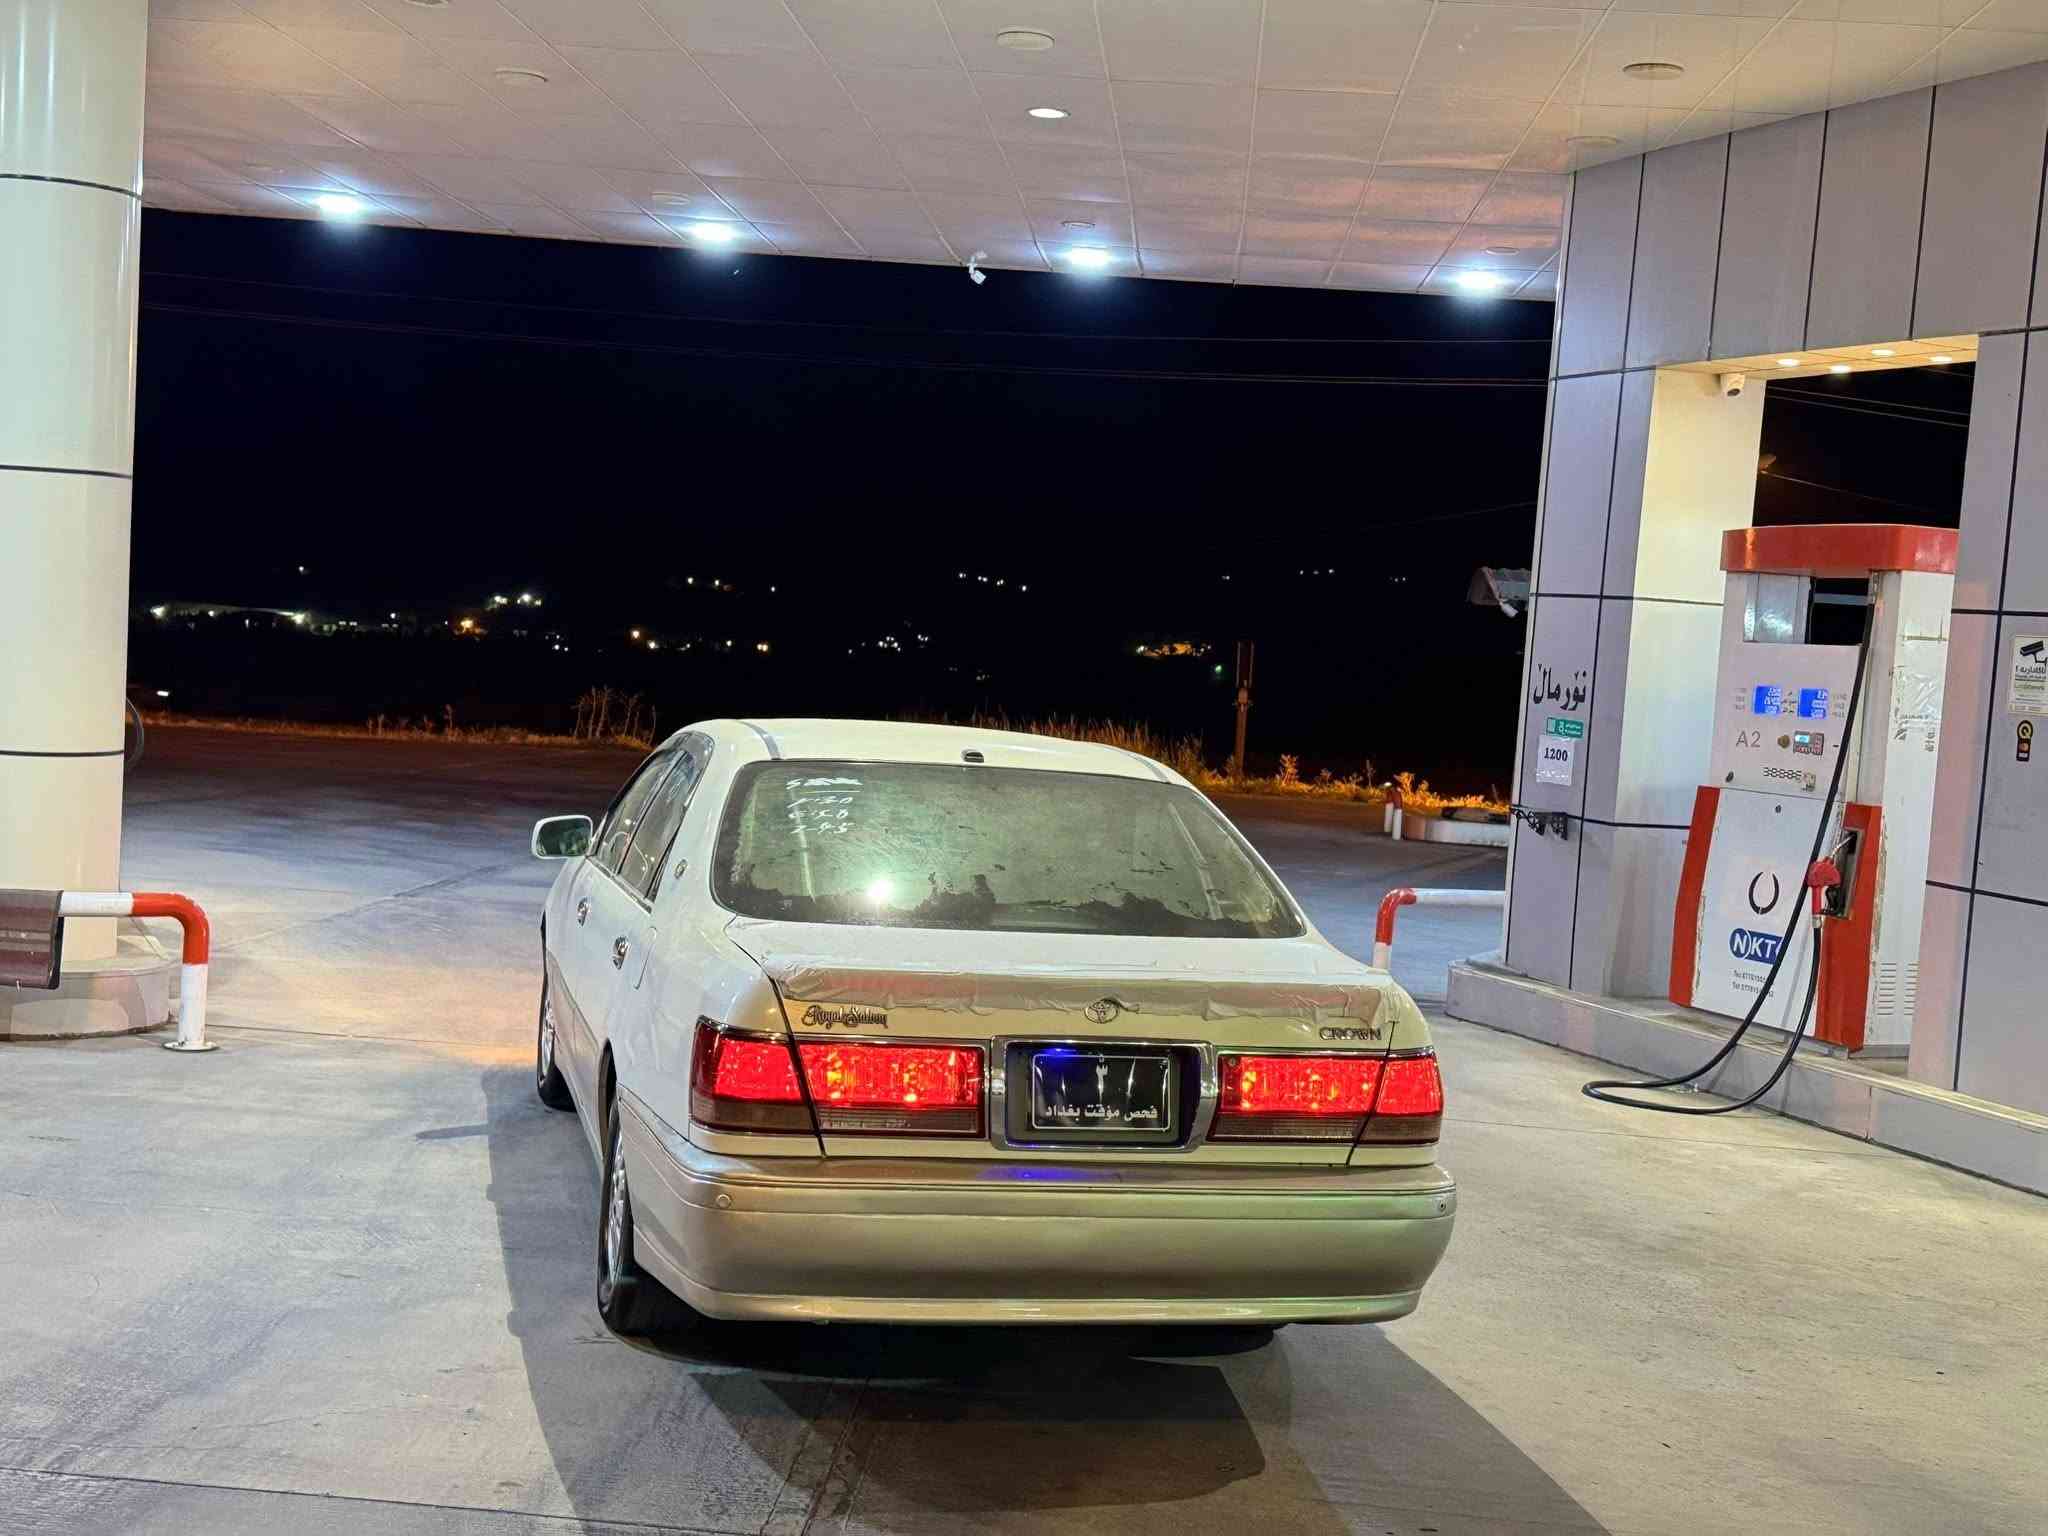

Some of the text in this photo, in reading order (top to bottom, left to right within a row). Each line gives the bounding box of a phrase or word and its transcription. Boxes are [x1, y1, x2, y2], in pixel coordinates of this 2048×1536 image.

[1735, 730, 1761, 748] A2
[1544, 747, 1568, 762] 1200
[1319, 1027, 1382, 1041] CROWN
[1045, 1103, 1158, 1121] فحص مؤقت بغداد
